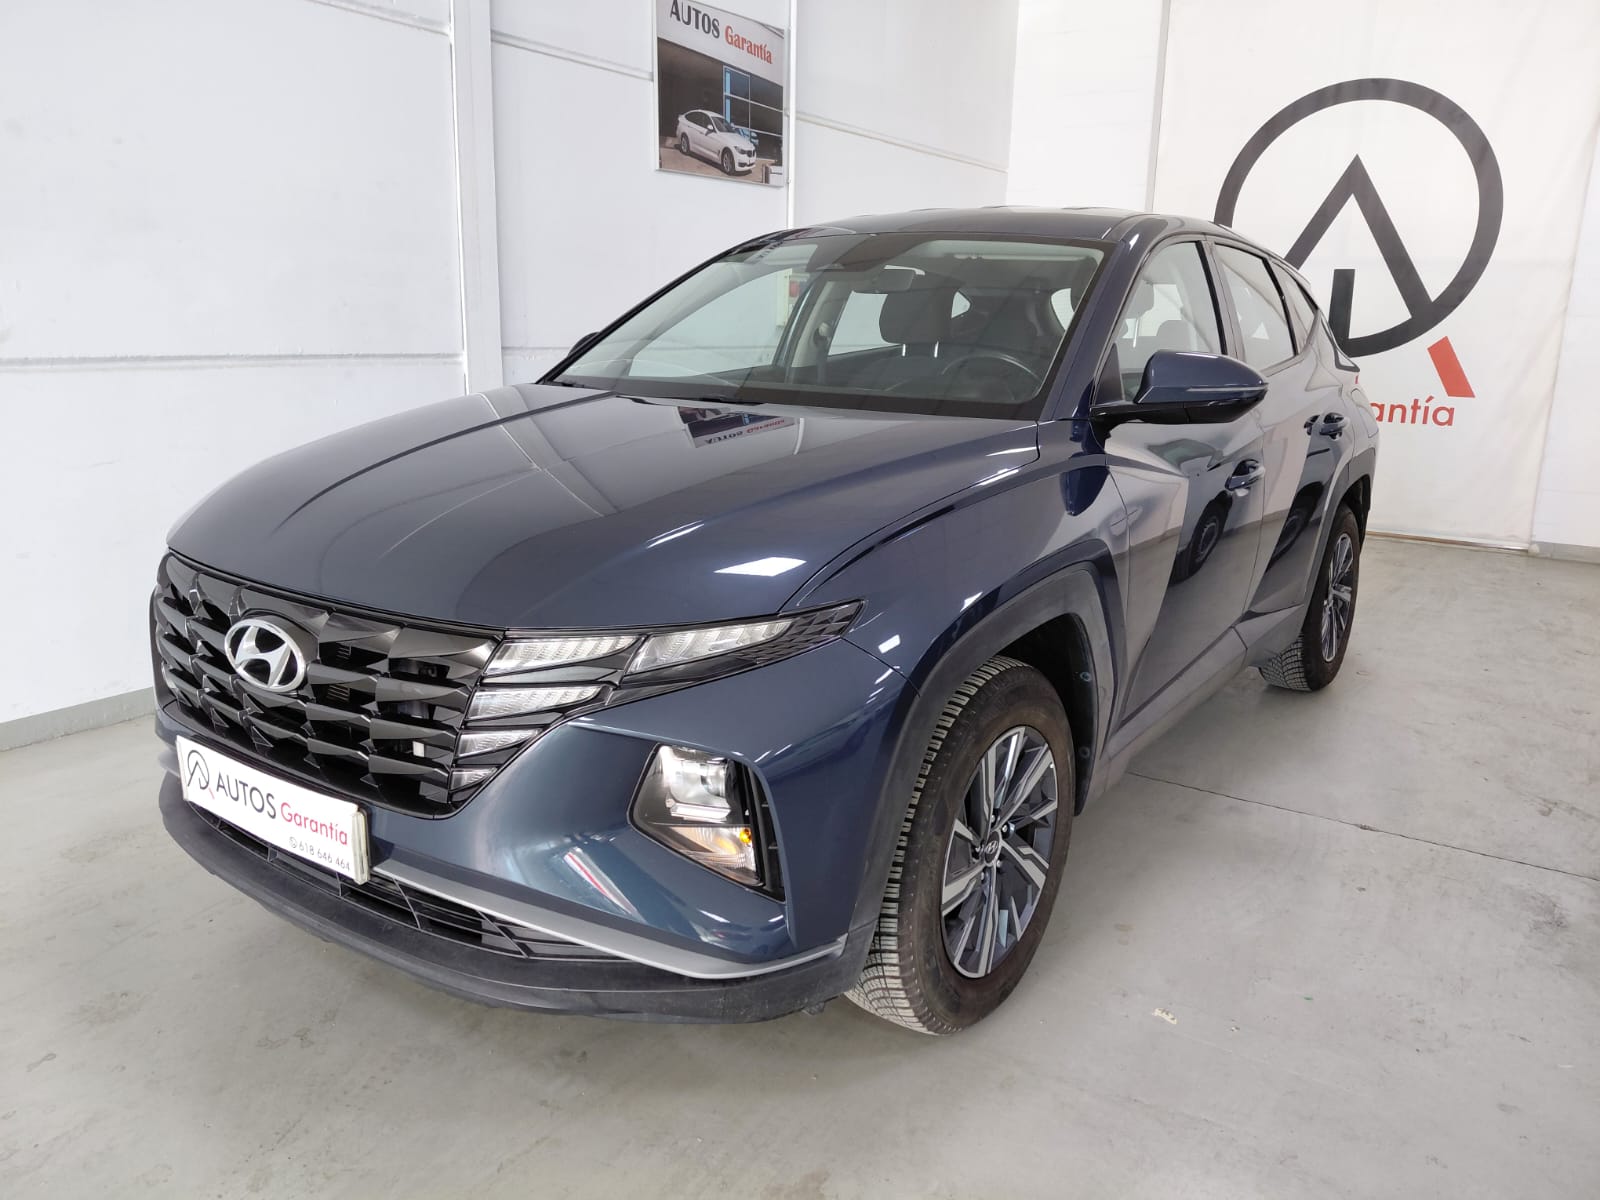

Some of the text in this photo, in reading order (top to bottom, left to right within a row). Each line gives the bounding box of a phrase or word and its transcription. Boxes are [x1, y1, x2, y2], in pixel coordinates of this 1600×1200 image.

[670, 0, 772, 64] AUTOS Garantía
[216, 772, 348, 845] AUTOS Garantía
